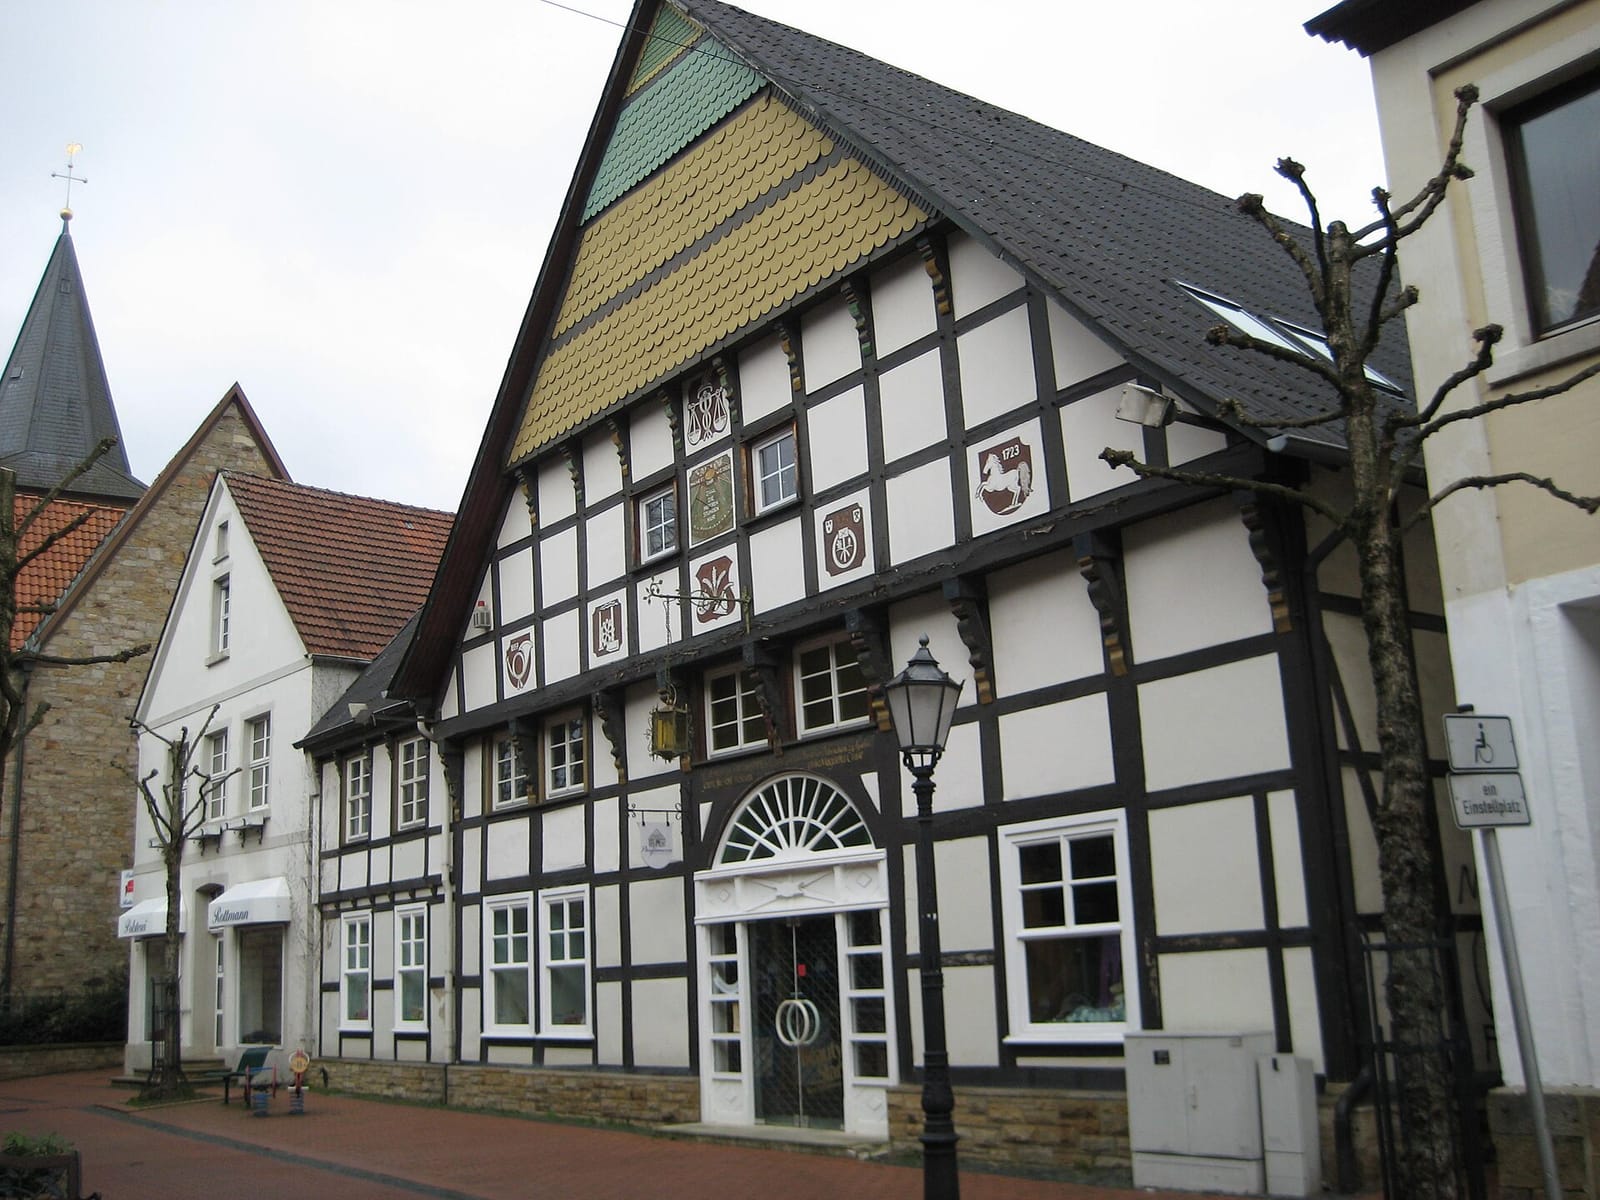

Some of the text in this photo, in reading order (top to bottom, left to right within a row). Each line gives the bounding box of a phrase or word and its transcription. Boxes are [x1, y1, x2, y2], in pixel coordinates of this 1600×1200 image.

[1002, 444, 1020, 461] 1723
[1483, 783, 1498, 796] ein
[1463, 799, 1521, 817] Einstellplatz
[212, 906, 249, 924] Rottmann
